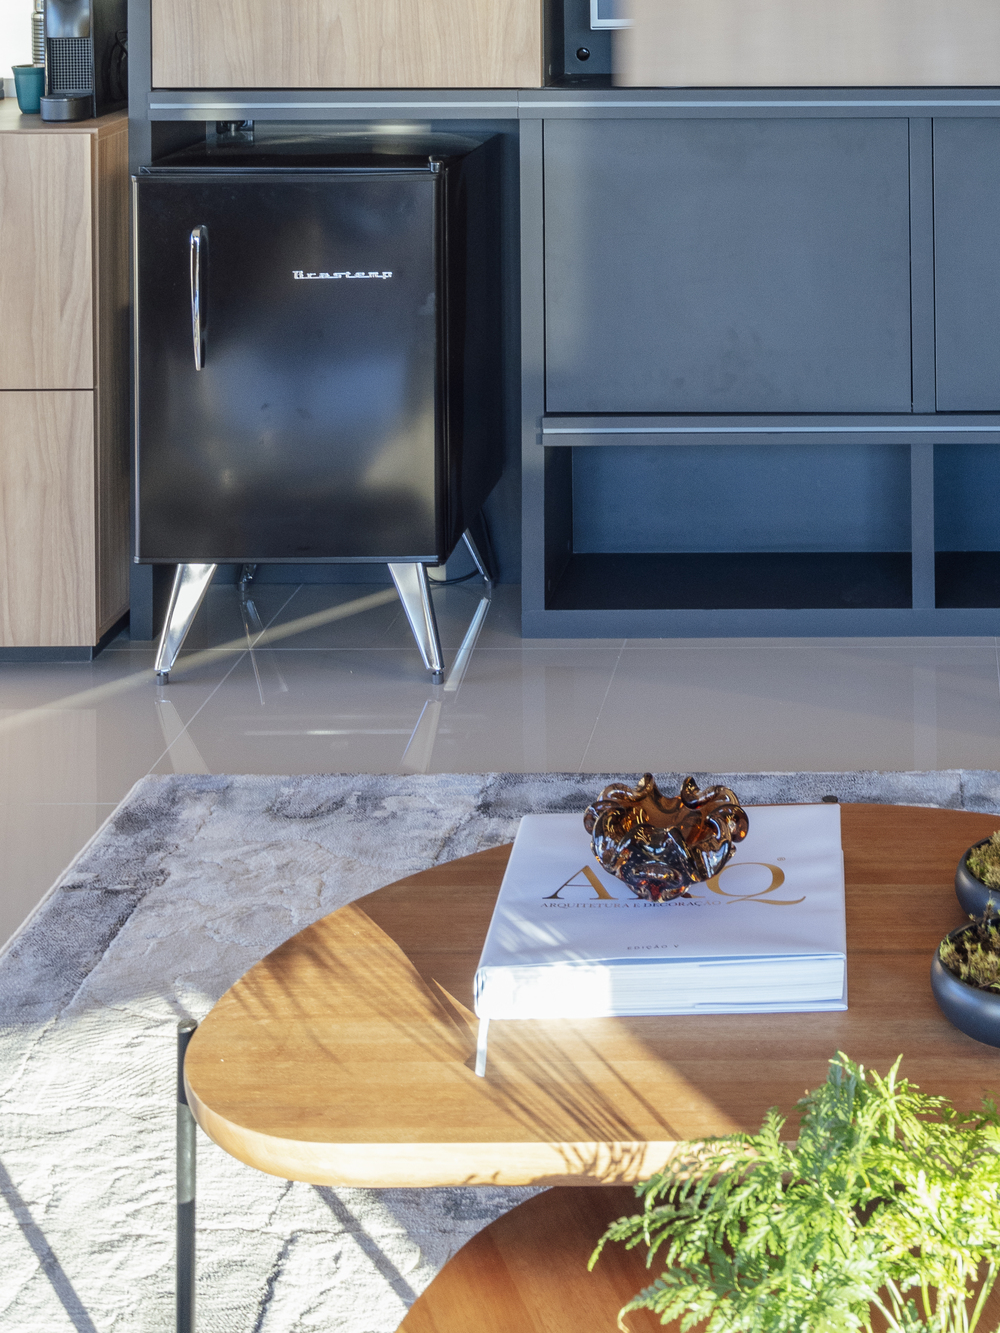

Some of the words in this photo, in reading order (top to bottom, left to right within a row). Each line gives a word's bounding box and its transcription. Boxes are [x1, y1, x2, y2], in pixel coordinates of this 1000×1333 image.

[292, 270, 393, 279] Brastemp
[542, 862, 806, 906] AQ
[643, 900, 721, 908] DECORAÇÃO
